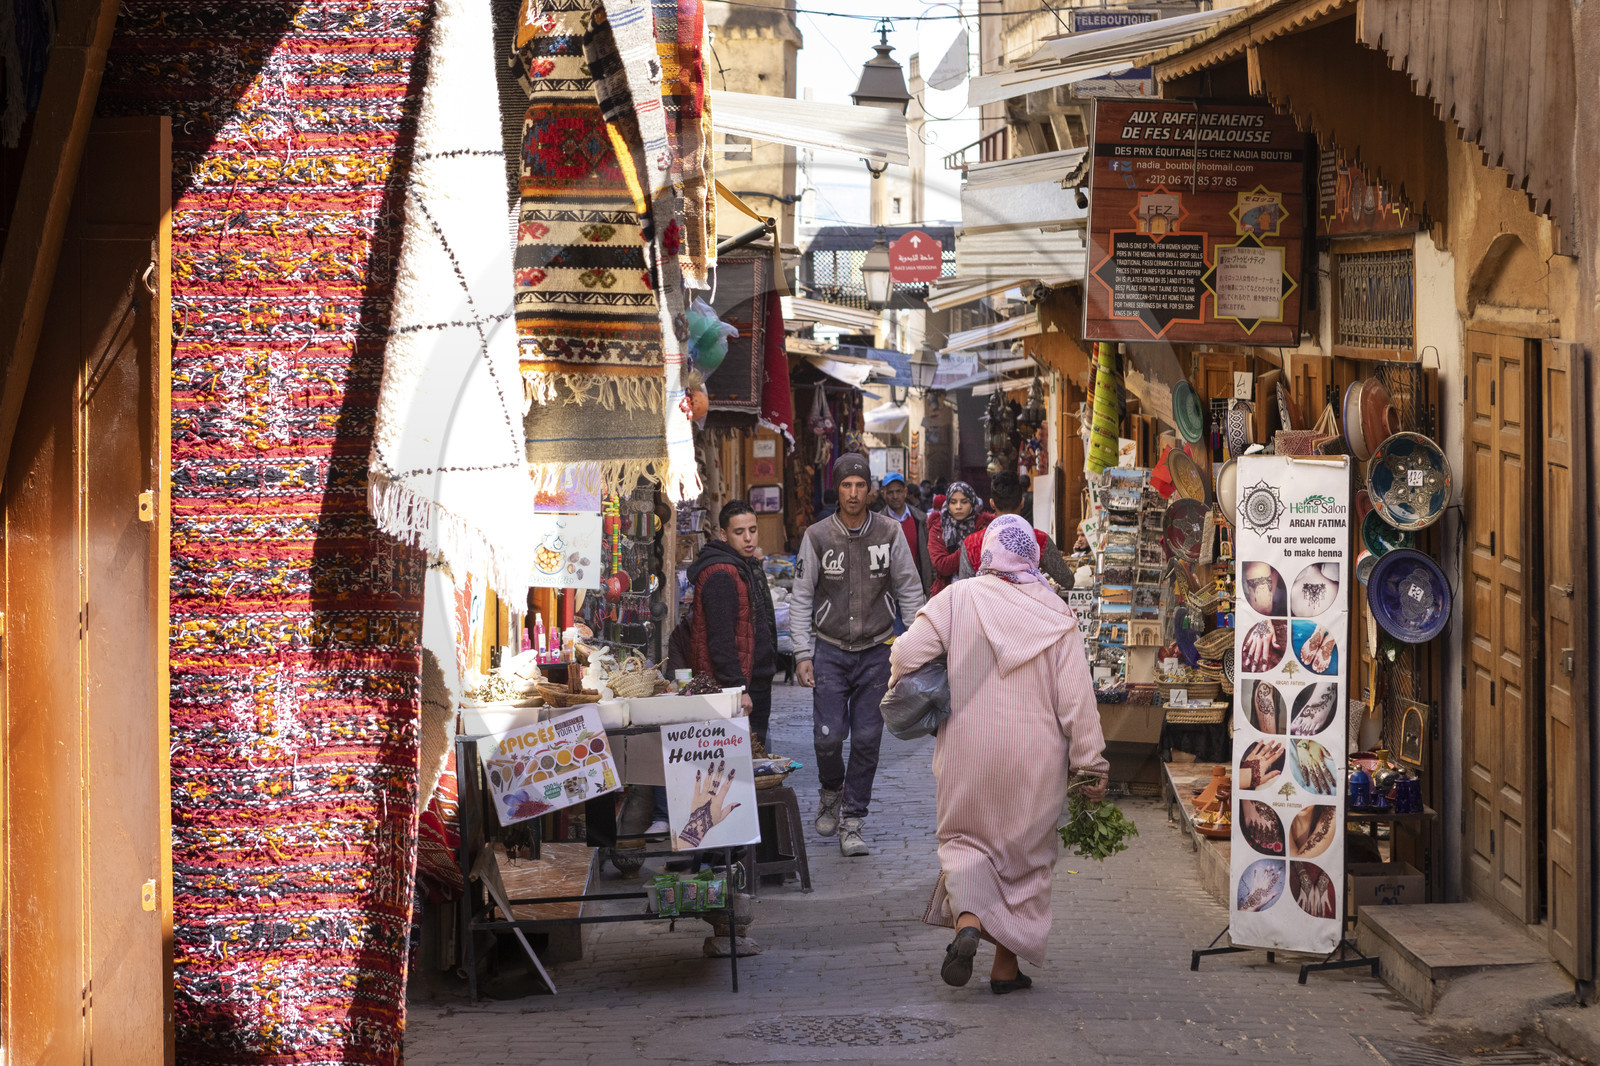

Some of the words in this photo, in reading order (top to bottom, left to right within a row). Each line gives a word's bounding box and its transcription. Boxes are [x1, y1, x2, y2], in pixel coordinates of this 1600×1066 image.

[1128, 111, 1158, 124] AUX
[1161, 112, 1264, 127] RAFFNEMENTS
[1121, 126, 1142, 139] DE
[1144, 128, 1171, 140] FES
[1114, 146, 1132, 156] DES
[1134, 147, 1153, 156] PRIX
[1210, 149, 1232, 158] CHEZ
[1234, 150, 1260, 159] NADIA
[1260, 151, 1292, 160] BOUTBI
[1146, 174, 1166, 184] +212
[1168, 176, 1181, 184] 06
[1184, 176, 1194, 185] 70
[1197, 176, 1210, 186] 85
[1211, 176, 1224, 186] 37
[1225, 177, 1238, 186] 85
[1147, 204, 1172, 215] FEZ
[1290, 502, 1318, 514] Henna
[1321, 502, 1347, 514] Salon
[1289, 519, 1315, 528] ARGAN
[1318, 519, 1347, 528] FATIMA
[1267, 535, 1282, 544] You
[1300, 536, 1336, 544] welcome
[822, 549, 845, 572] Cal
[868, 543, 890, 570] M
[1294, 549, 1316, 557] make
[1318, 549, 1342, 558] henna
[556, 726, 573, 738] YOUR
[573, 722, 586, 732] LIFE
[667, 726, 726, 742] welcom
[499, 726, 555, 756] SPICES
[698, 738, 710, 748] to
[713, 735, 743, 747] make
[669, 748, 724, 764] Henna
